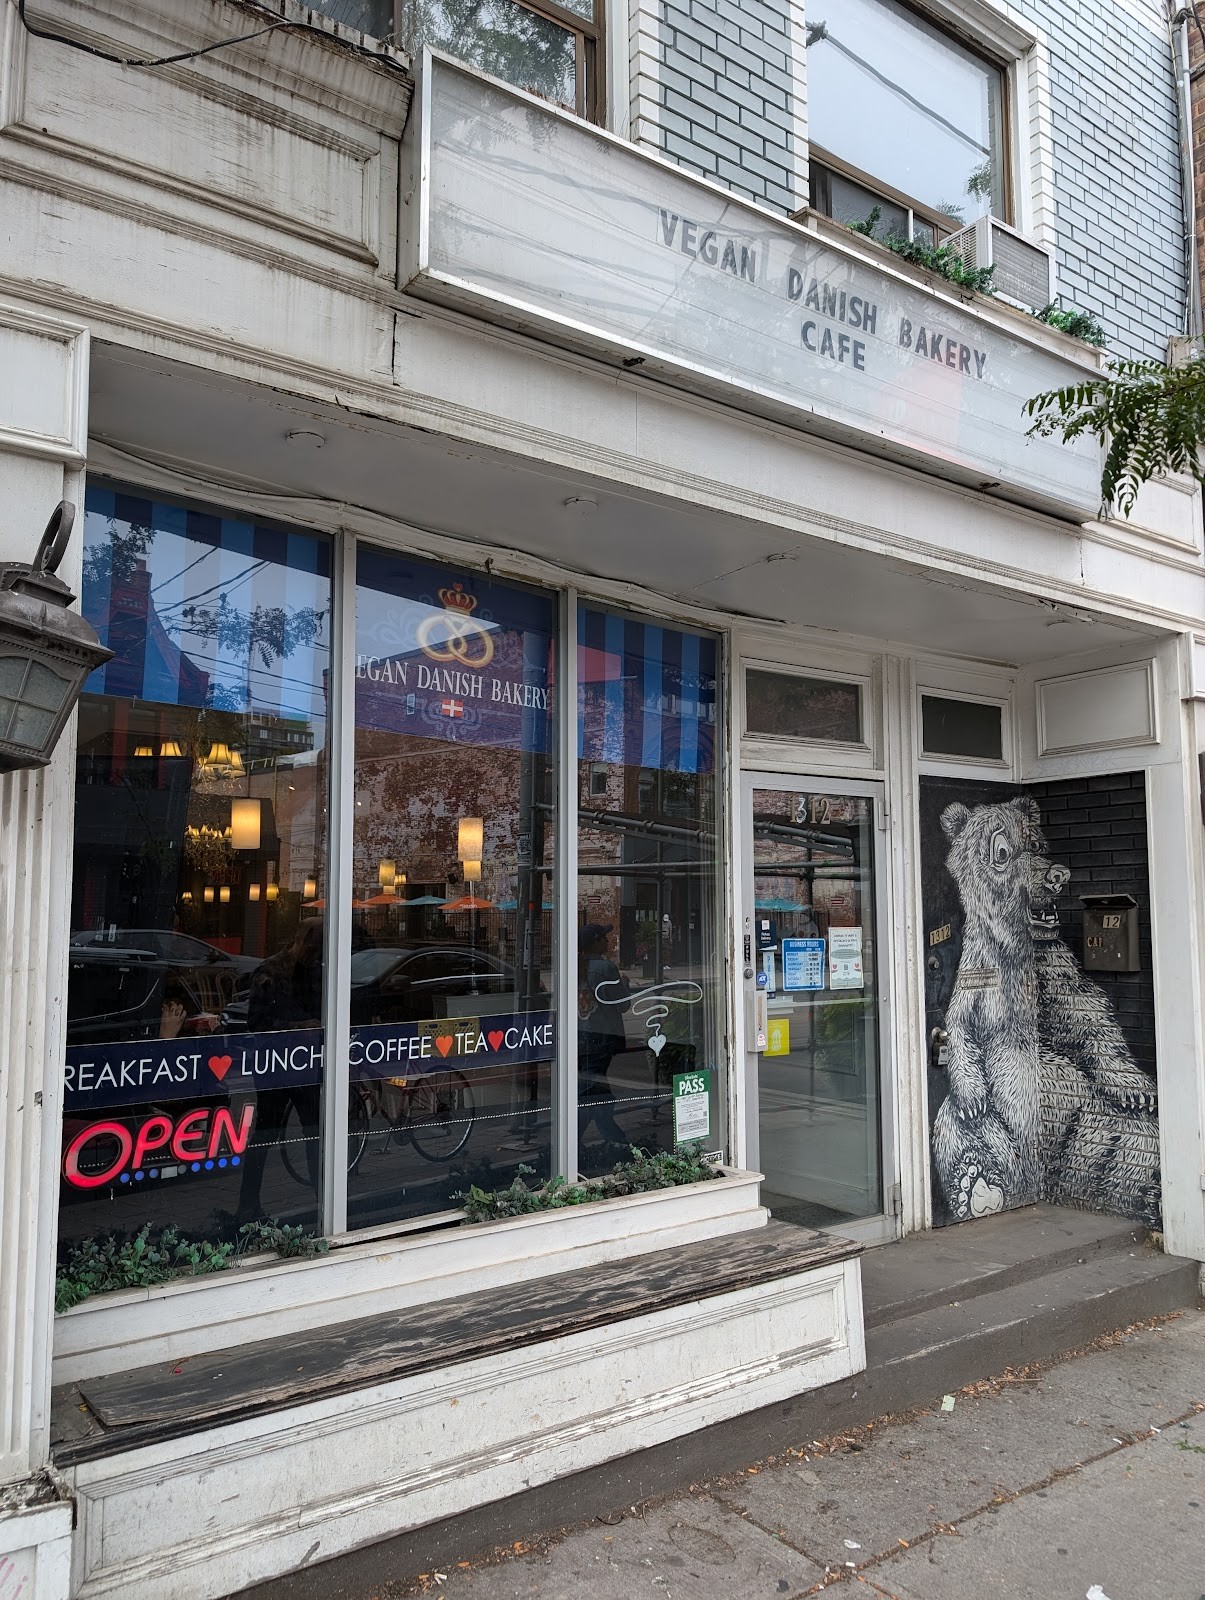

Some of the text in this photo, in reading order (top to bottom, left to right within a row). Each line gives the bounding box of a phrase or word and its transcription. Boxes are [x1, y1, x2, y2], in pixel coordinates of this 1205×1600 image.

[660, 208, 986, 379] VEGAN DANISH BAKERY
[801, 320, 866, 371] CAFE
[356, 654, 551, 710] EGAN DANISH BAKERY
[931, 925, 950, 944] 1312
[1105, 916, 1120, 928] 12
[349, 1024, 553, 1065] COFFEE TEA CAKE
[63, 1045, 324, 1092] REAKFAST LUNCH
[679, 1077, 705, 1096] PASS
[63, 1104, 256, 1190] OPEN
